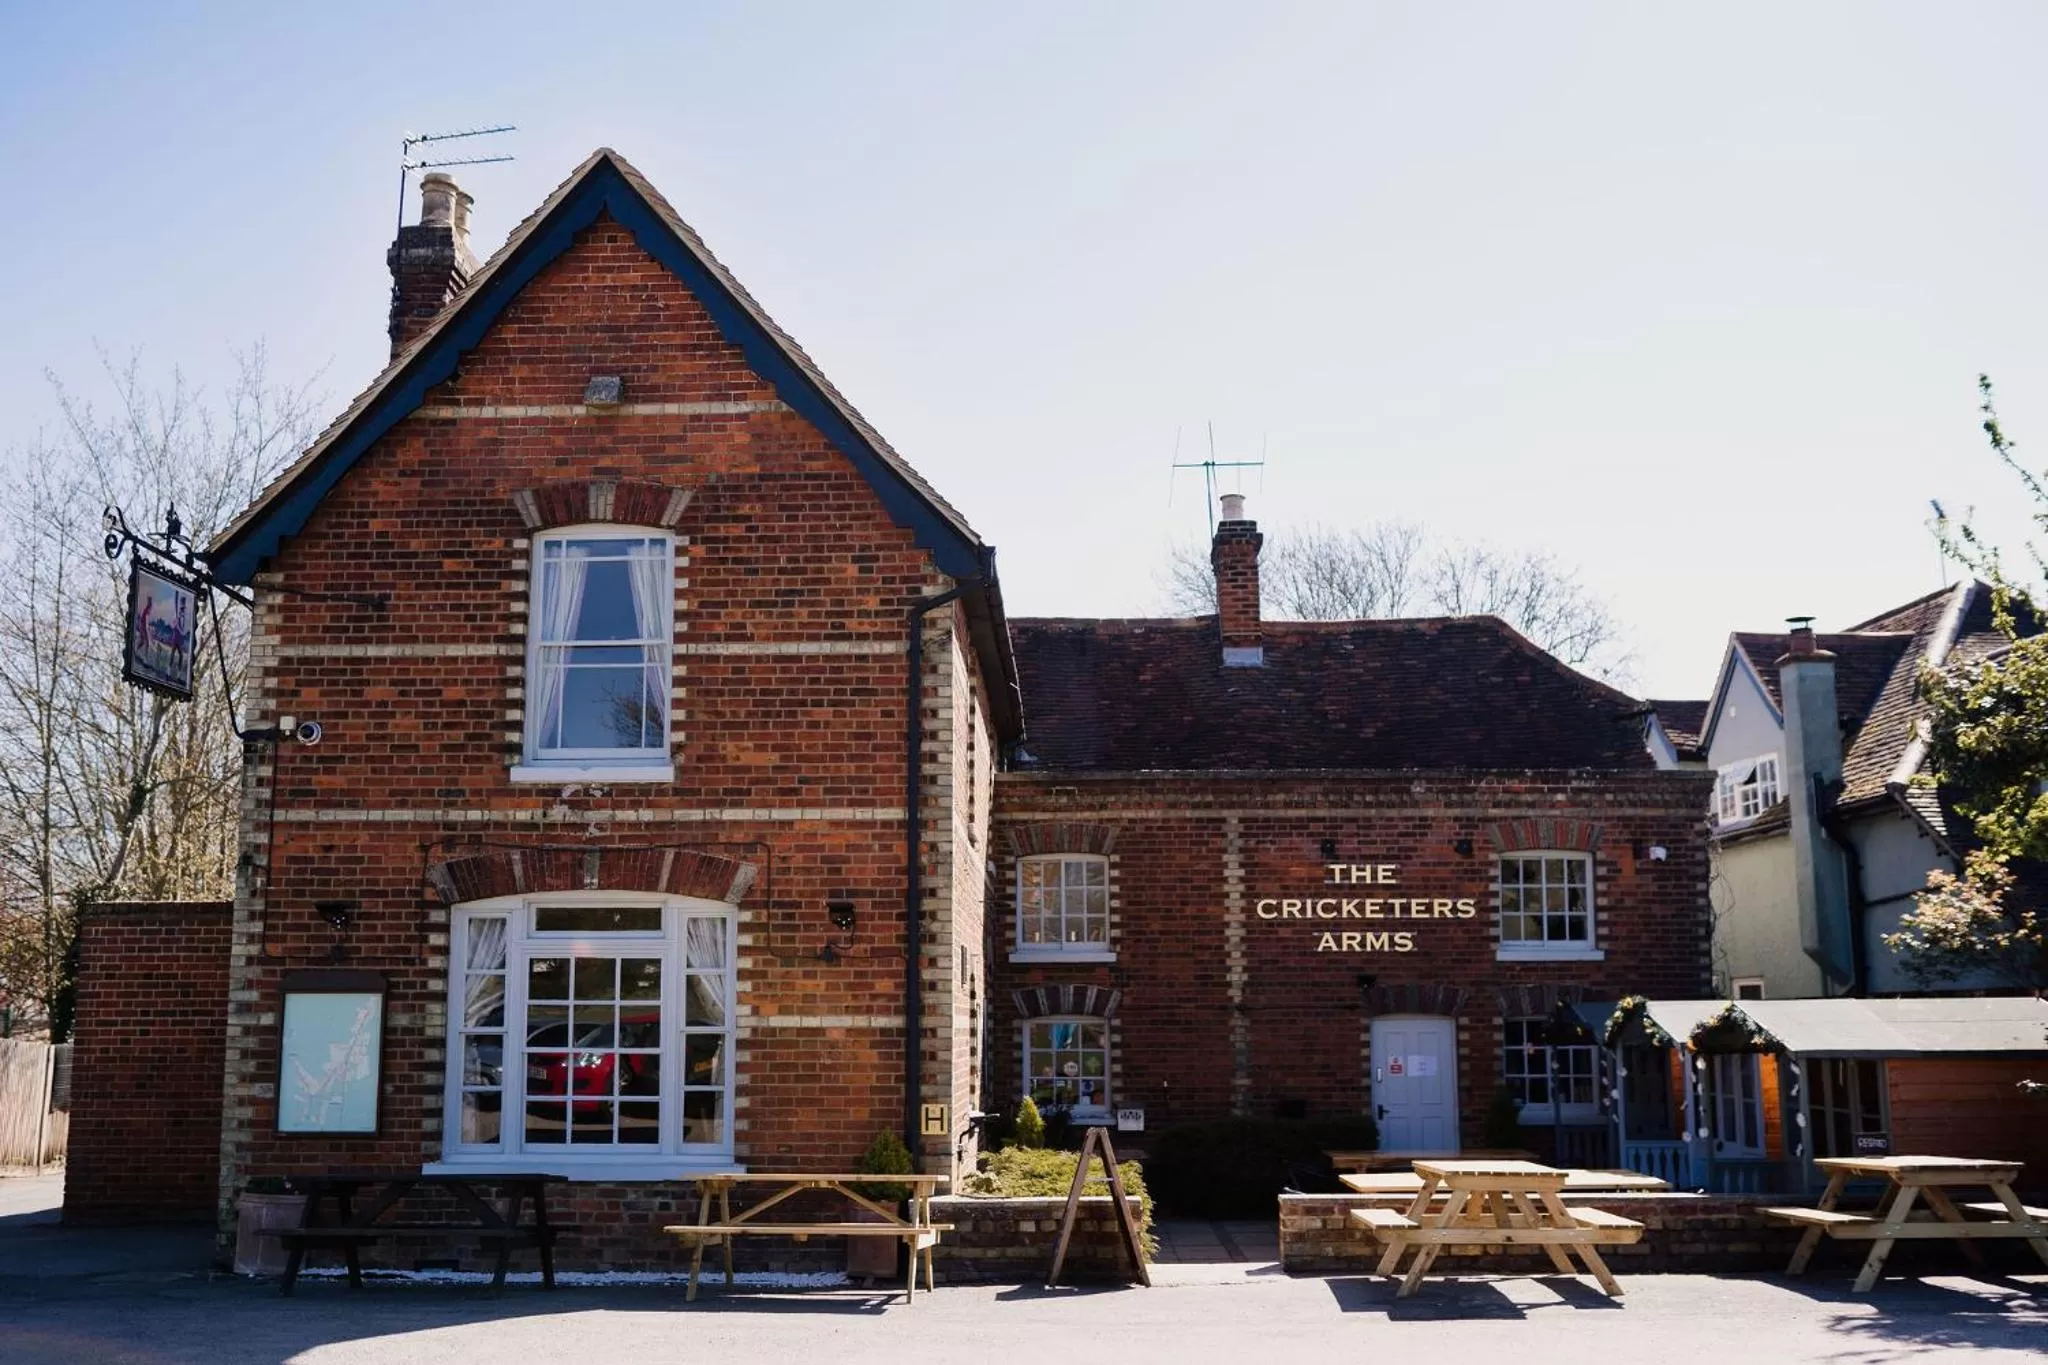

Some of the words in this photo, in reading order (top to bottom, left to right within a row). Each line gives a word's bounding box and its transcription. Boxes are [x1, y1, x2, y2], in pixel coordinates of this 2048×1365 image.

[1328, 864, 1397, 884] THE
[1256, 899, 1476, 919] CRICKETERS
[1317, 932, 1413, 951] ARMS
[926, 1107, 944, 1131] H
